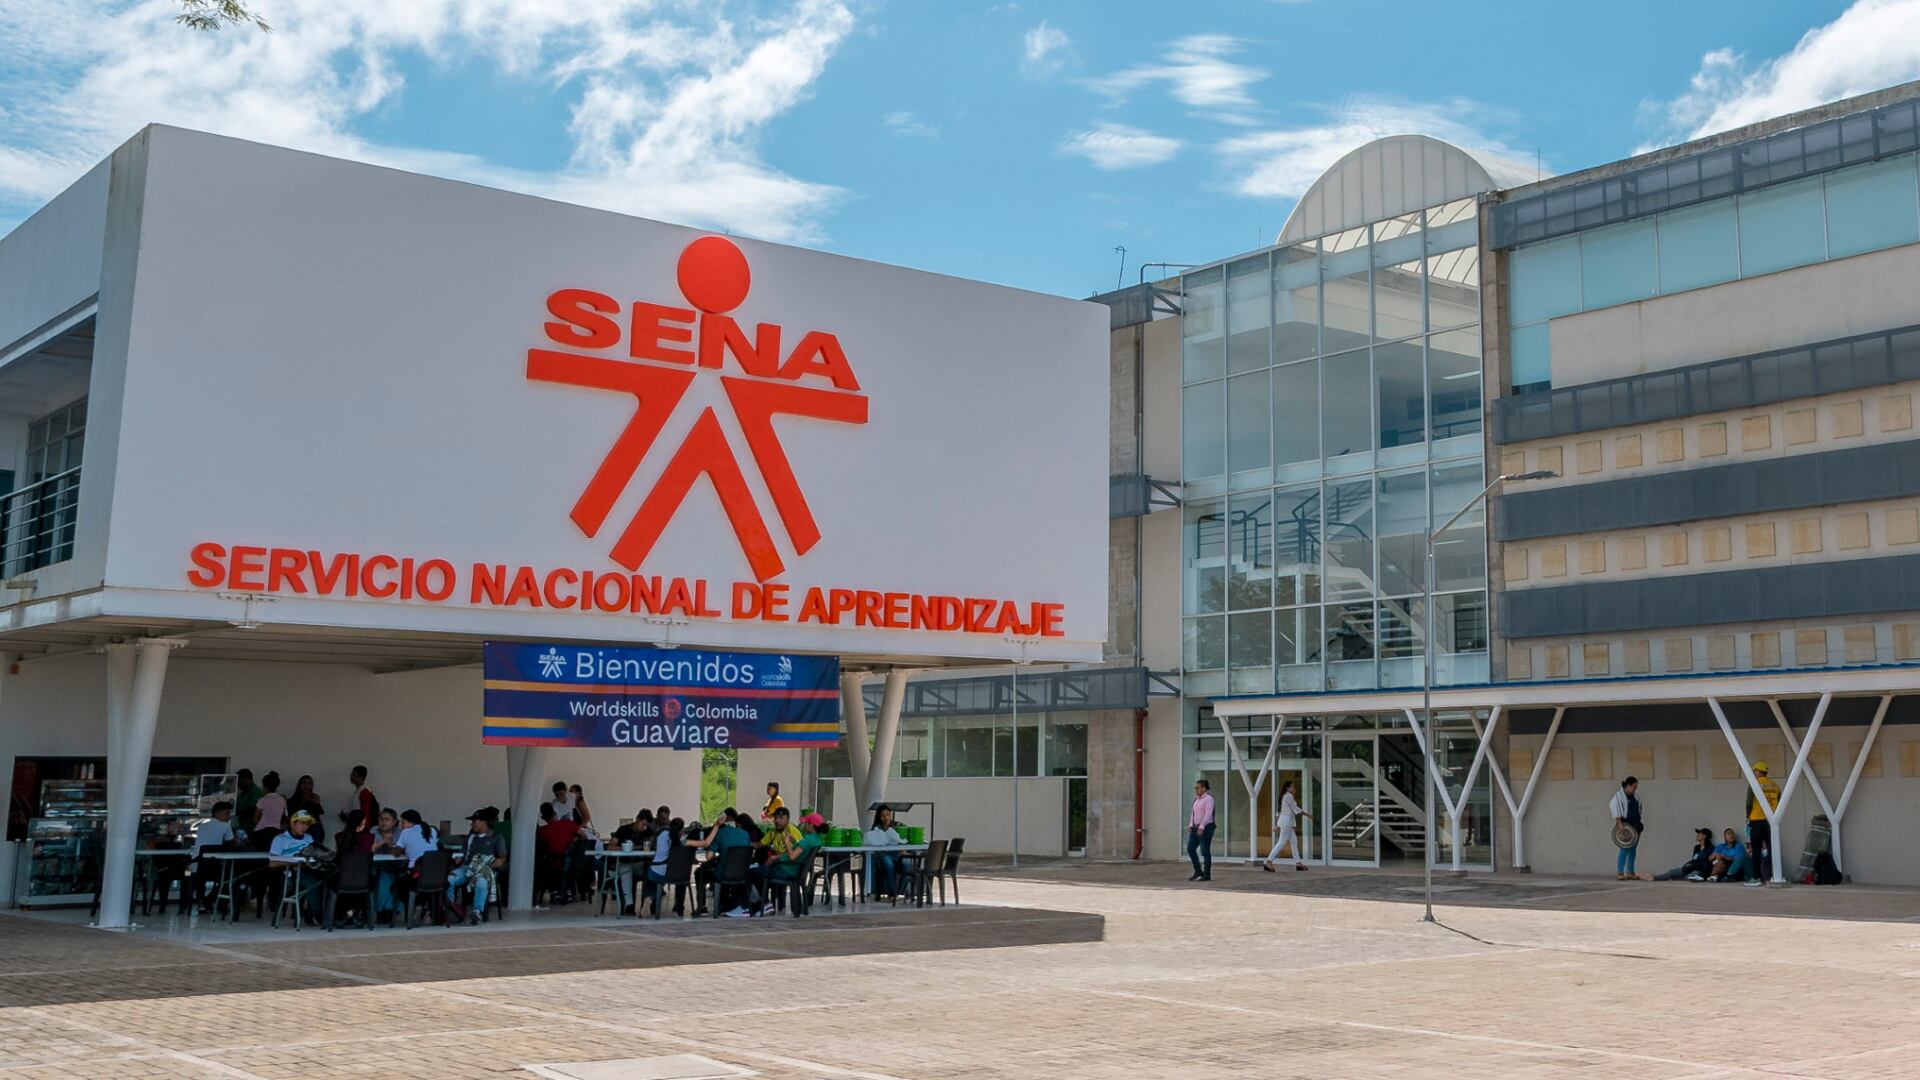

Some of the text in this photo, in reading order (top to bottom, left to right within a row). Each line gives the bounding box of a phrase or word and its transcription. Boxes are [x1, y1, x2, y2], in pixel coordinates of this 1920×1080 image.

[544, 288, 861, 391] SENA
[187, 542, 1065, 638] SERVICIO NACIONAL DE APRENDIZAJE
[539, 654, 566, 662] SENA
[575, 651, 755, 683] Bienvenidos
[569, 701, 758, 720] Worldskills Colombia
[611, 718, 729, 745] Guaviare
